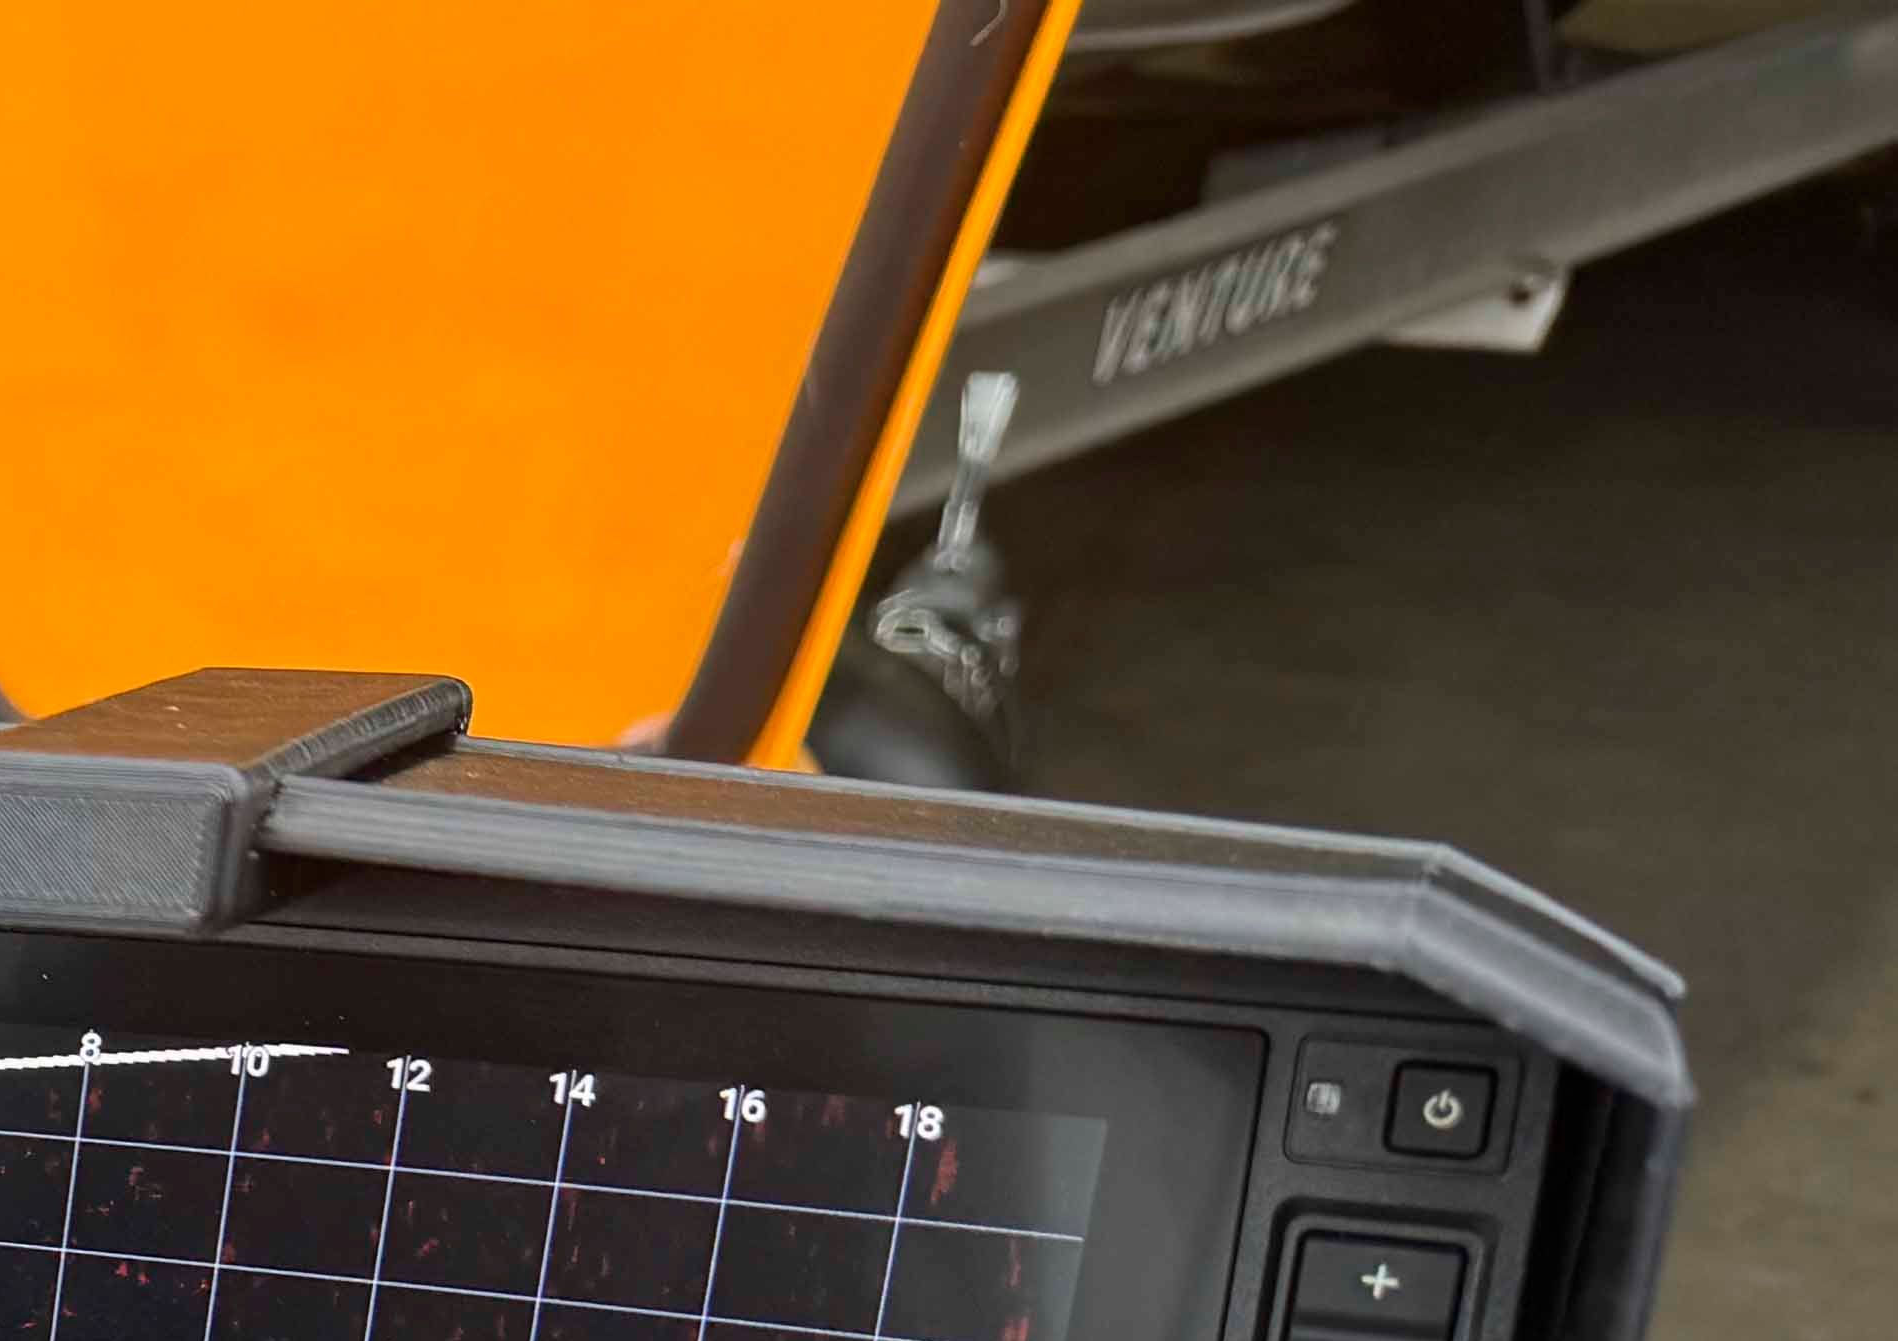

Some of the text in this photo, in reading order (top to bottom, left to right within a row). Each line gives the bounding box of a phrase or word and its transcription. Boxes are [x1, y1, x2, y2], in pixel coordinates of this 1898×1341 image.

[1092, 222, 1338, 385] VENTURE
[80, 1032, 103, 1063] 8
[228, 1045, 271, 1077] 10
[386, 1058, 432, 1092] 12
[550, 1073, 596, 1105] 14
[720, 1088, 767, 1124] 16
[894, 1104, 944, 1140] 18
